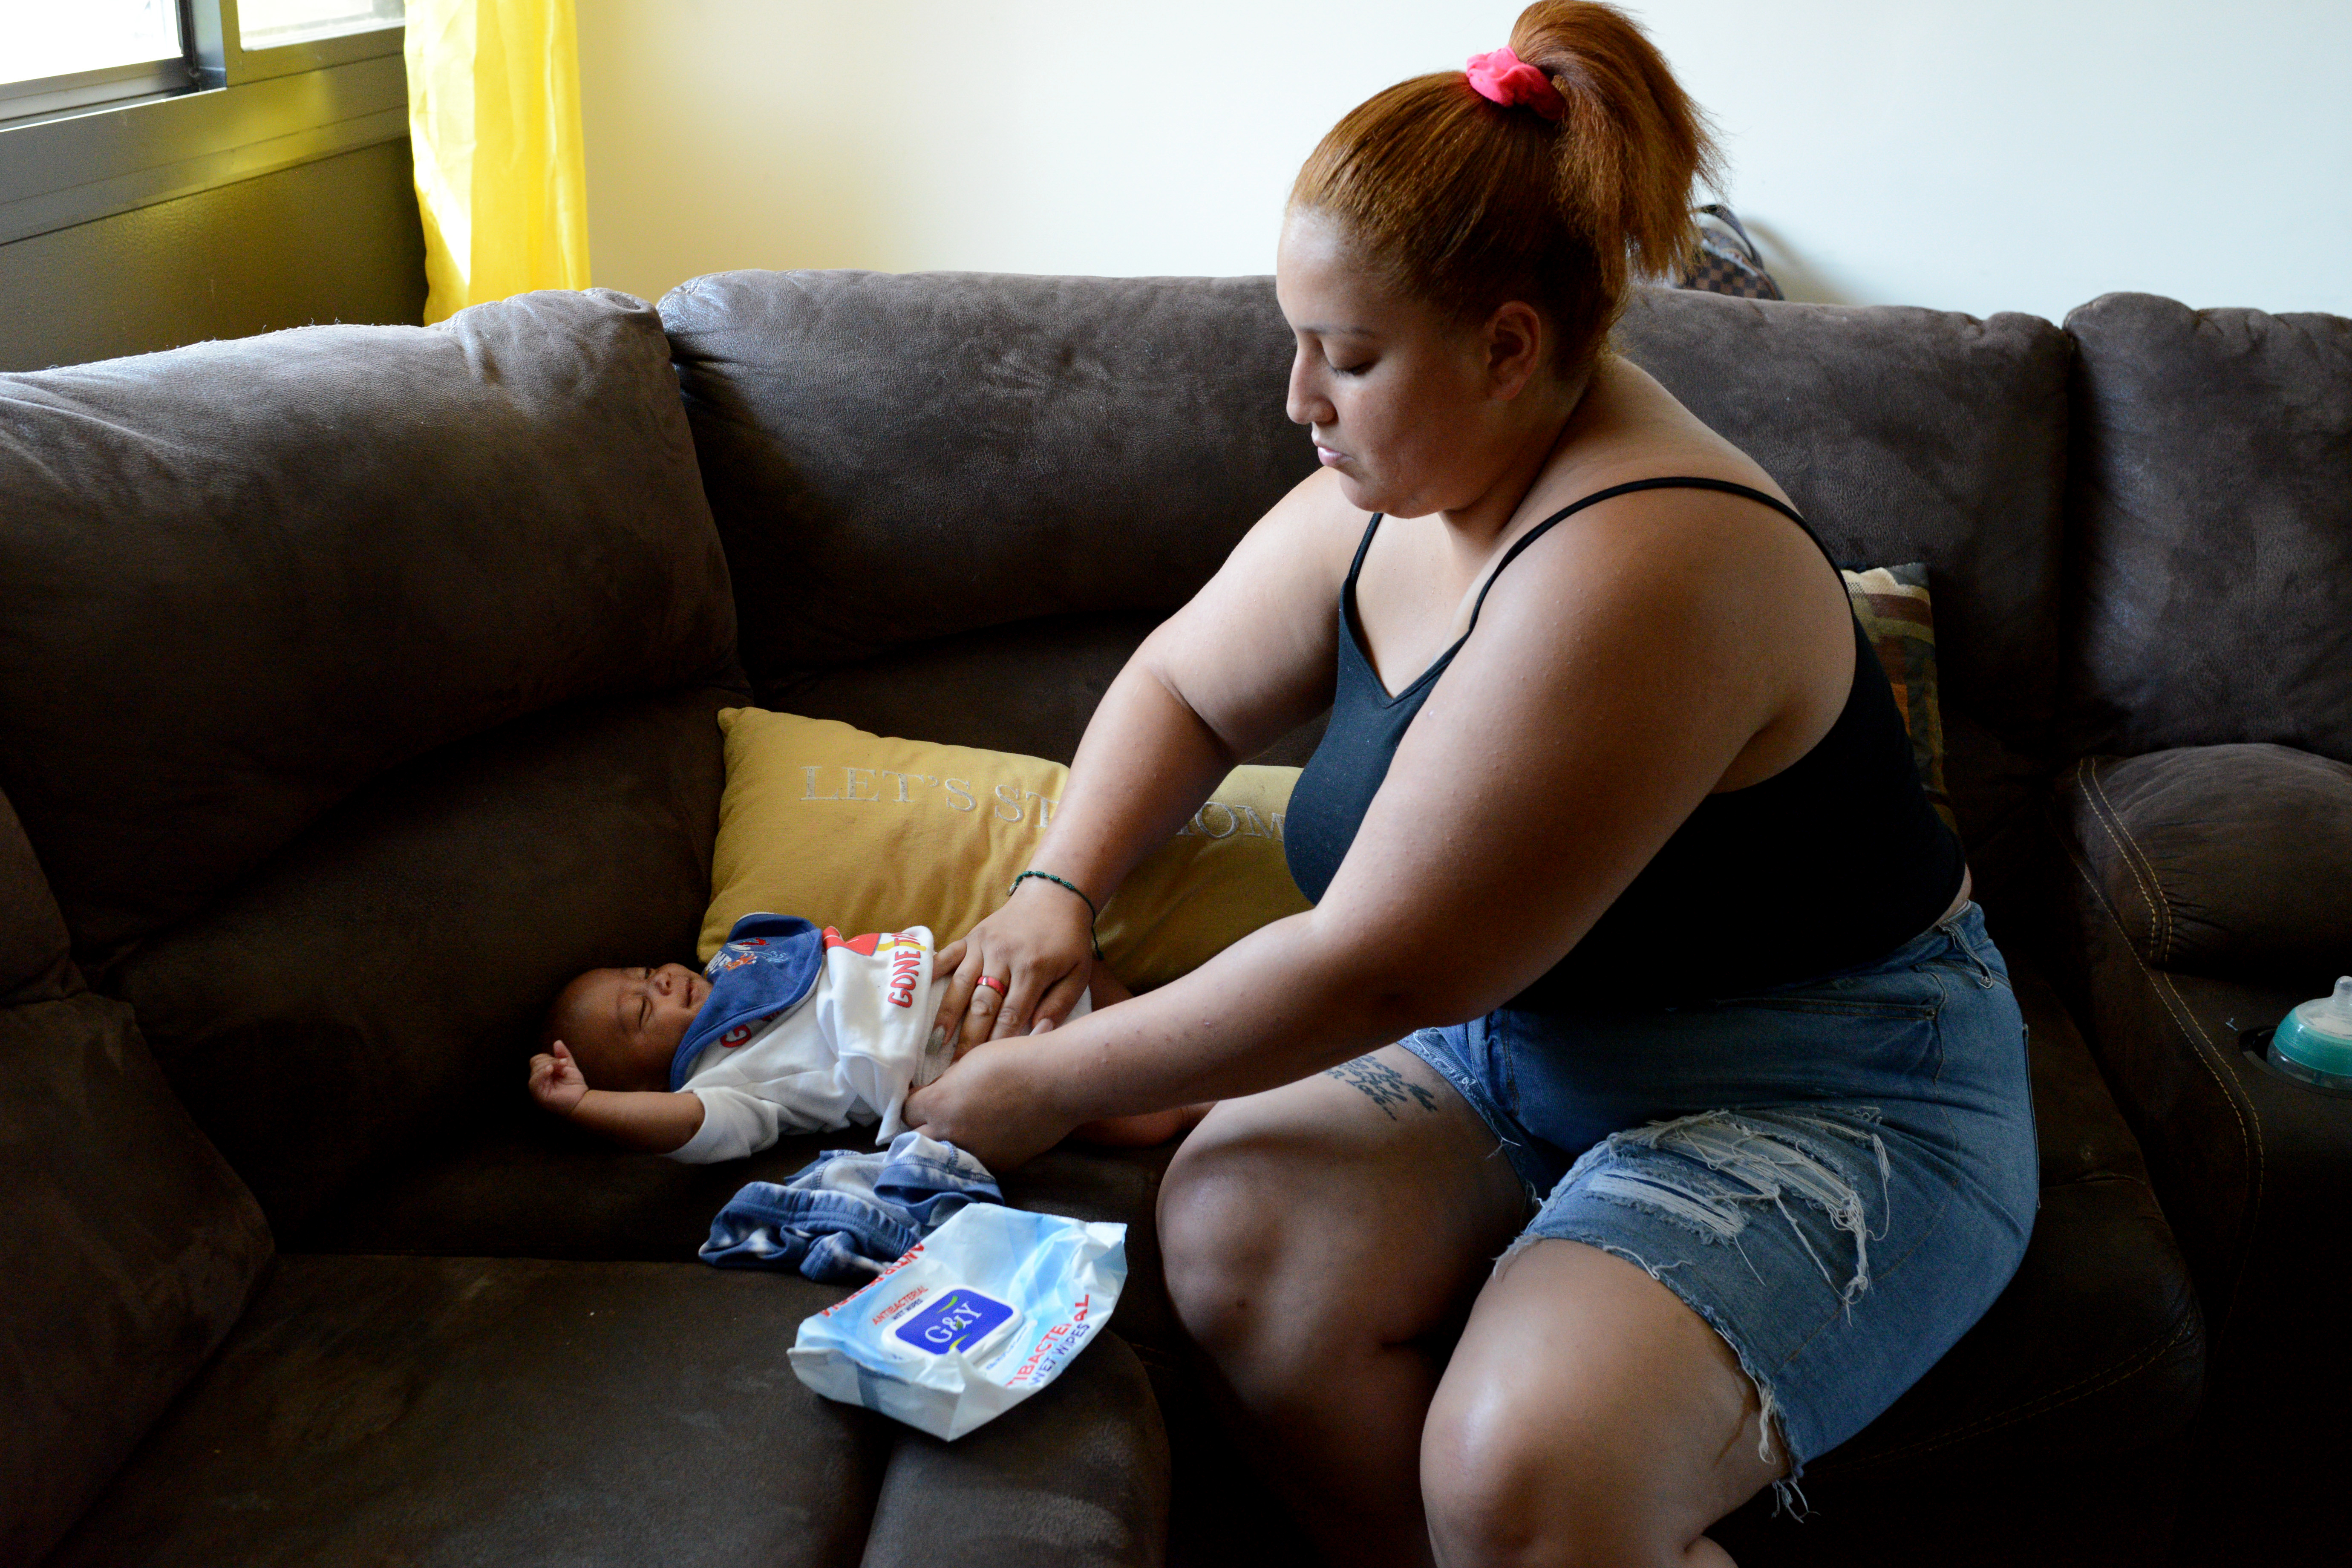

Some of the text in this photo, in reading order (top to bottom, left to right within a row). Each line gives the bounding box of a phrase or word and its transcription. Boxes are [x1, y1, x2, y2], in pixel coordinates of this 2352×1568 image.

[799, 765, 976, 811] LET'S
[994, 784, 1059, 828] ST
[888, 951, 921, 1008] GONE
[872, 1286, 928, 1326] ANTIBACTERIAL
[892, 1298, 923, 1320] WET WIPES
[925, 1301, 982, 1343] G&Y
[1029, 1323, 1090, 1386] WET WIPES
